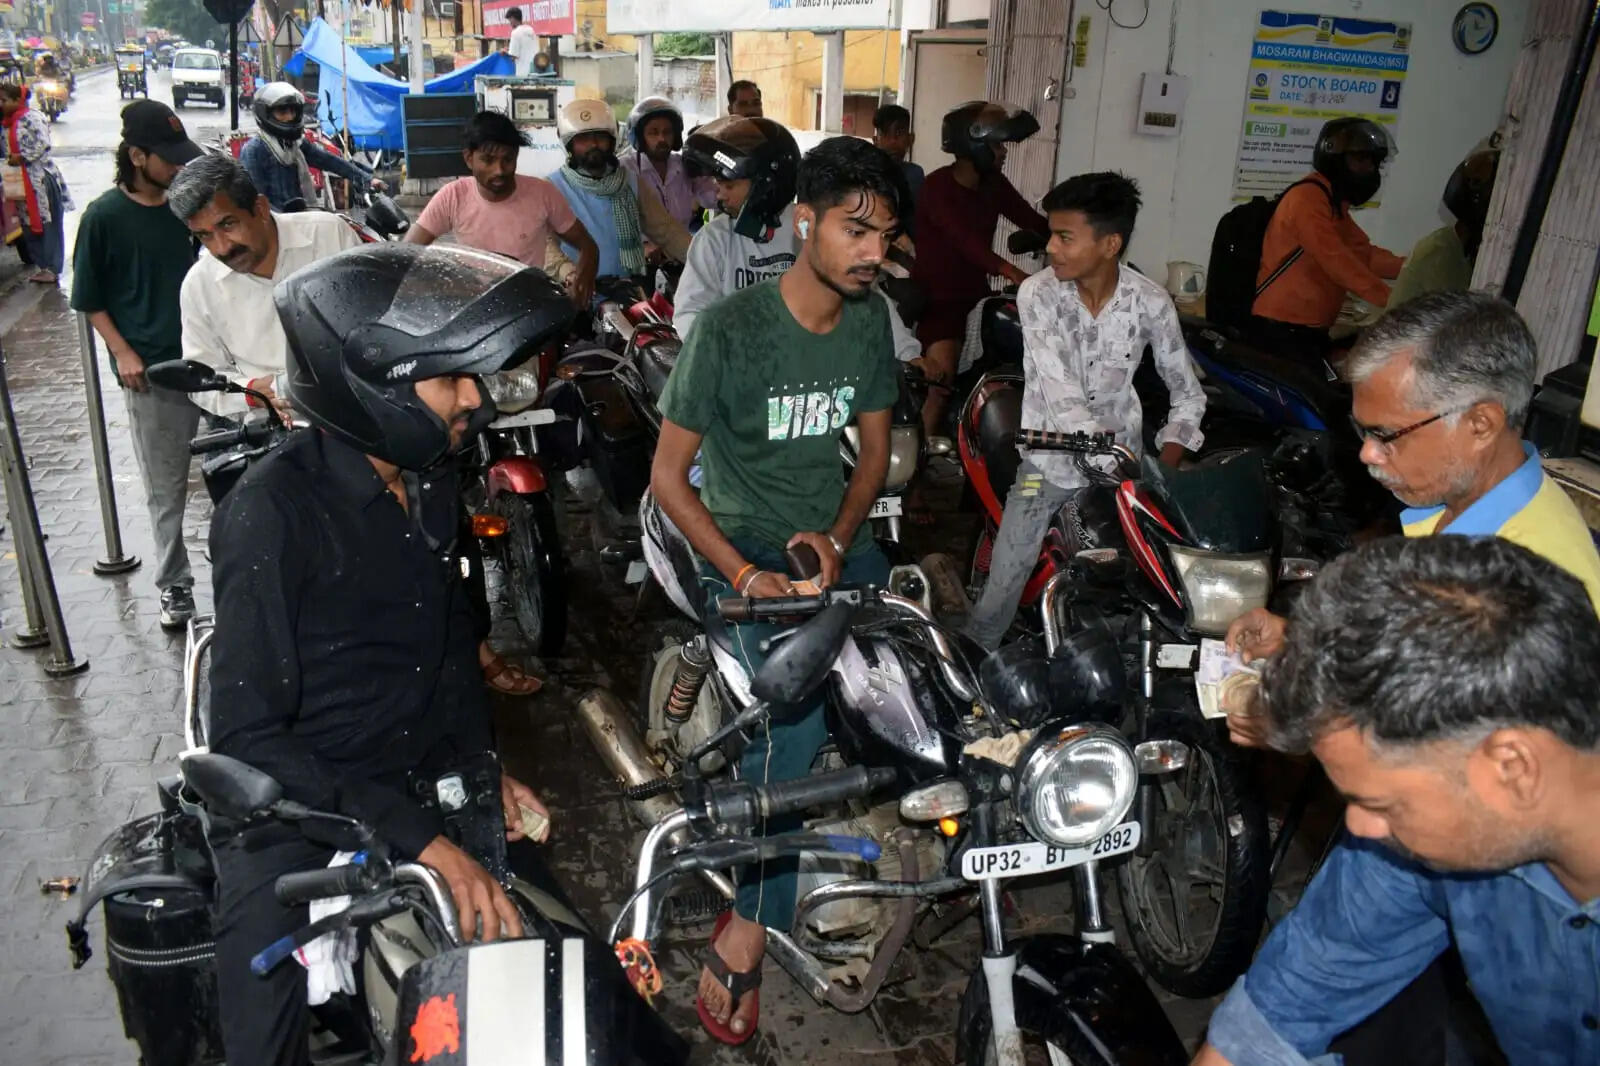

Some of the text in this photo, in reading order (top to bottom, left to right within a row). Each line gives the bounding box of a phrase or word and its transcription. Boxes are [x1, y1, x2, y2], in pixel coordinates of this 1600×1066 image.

[1257, 45, 1310, 59] MOSARAM
[1280, 74, 1377, 94] STOCK BOARD
[971, 850, 1021, 875] UP32
[1093, 828, 1132, 856] 2892
